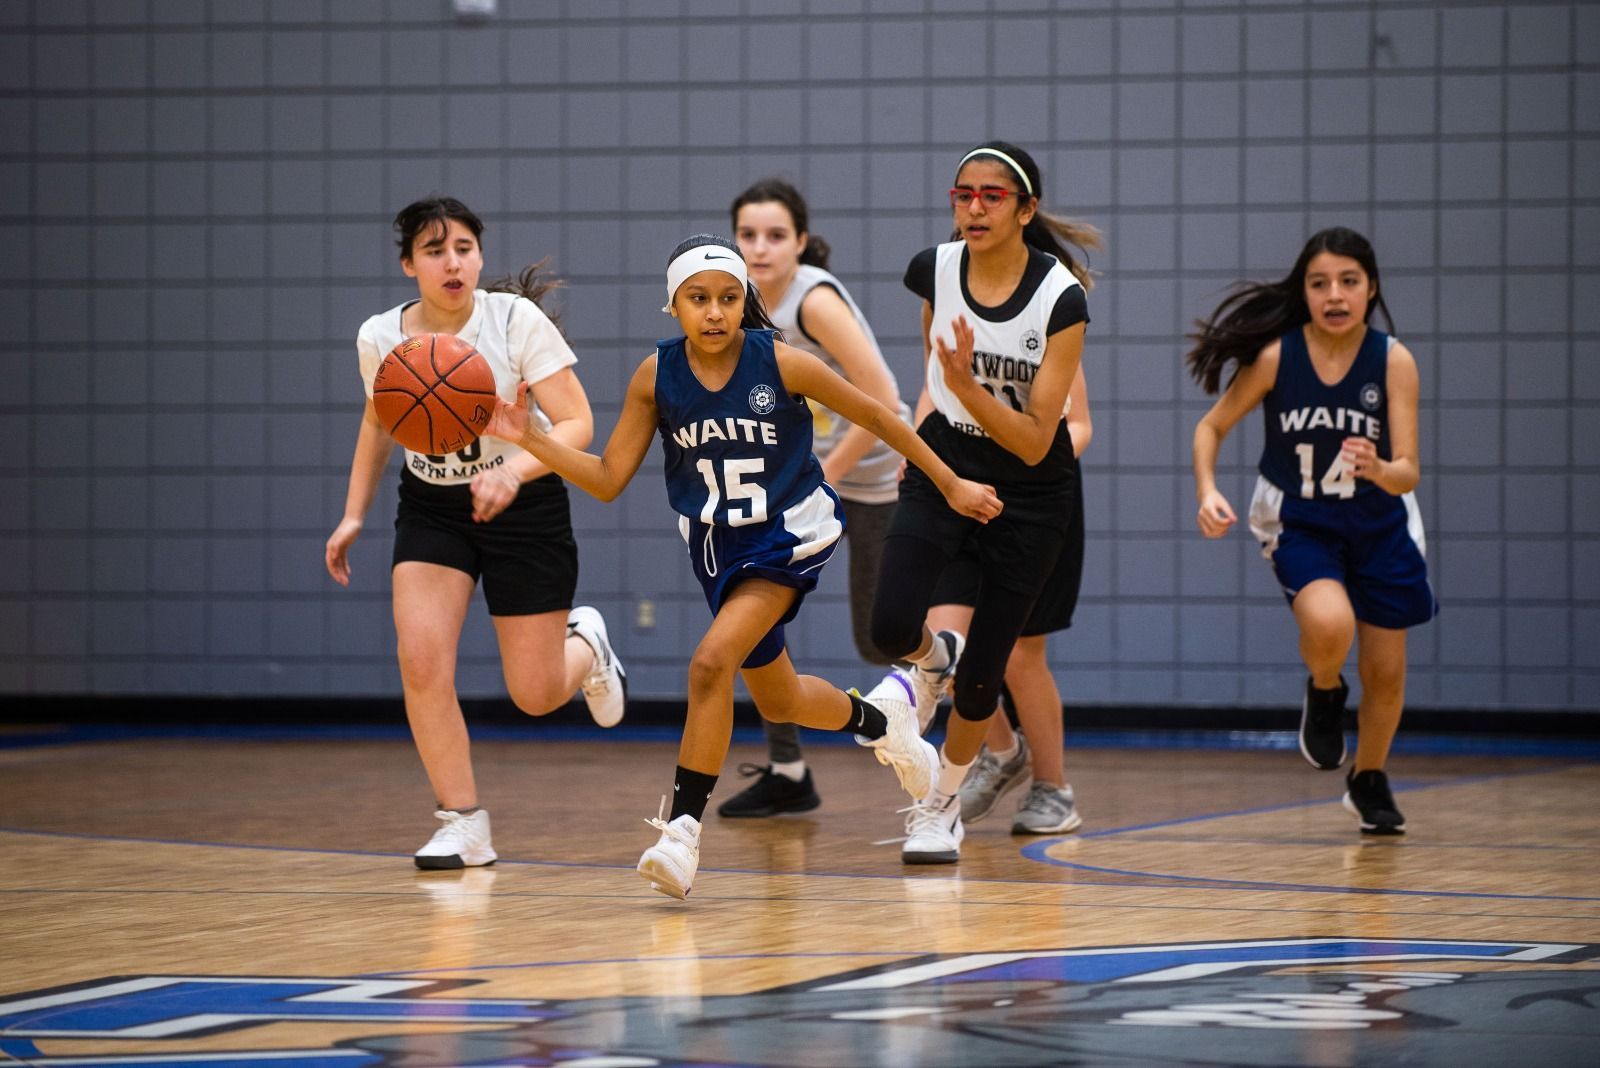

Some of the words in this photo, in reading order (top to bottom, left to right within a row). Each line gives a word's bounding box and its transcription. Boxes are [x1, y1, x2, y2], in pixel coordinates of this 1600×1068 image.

[672, 418, 778, 449] WAITE
[1280, 406, 1380, 440] WAITE
[411, 455, 446, 479] BRYN
[1295, 443, 1356, 499] 14
[696, 458, 768, 527] 15
